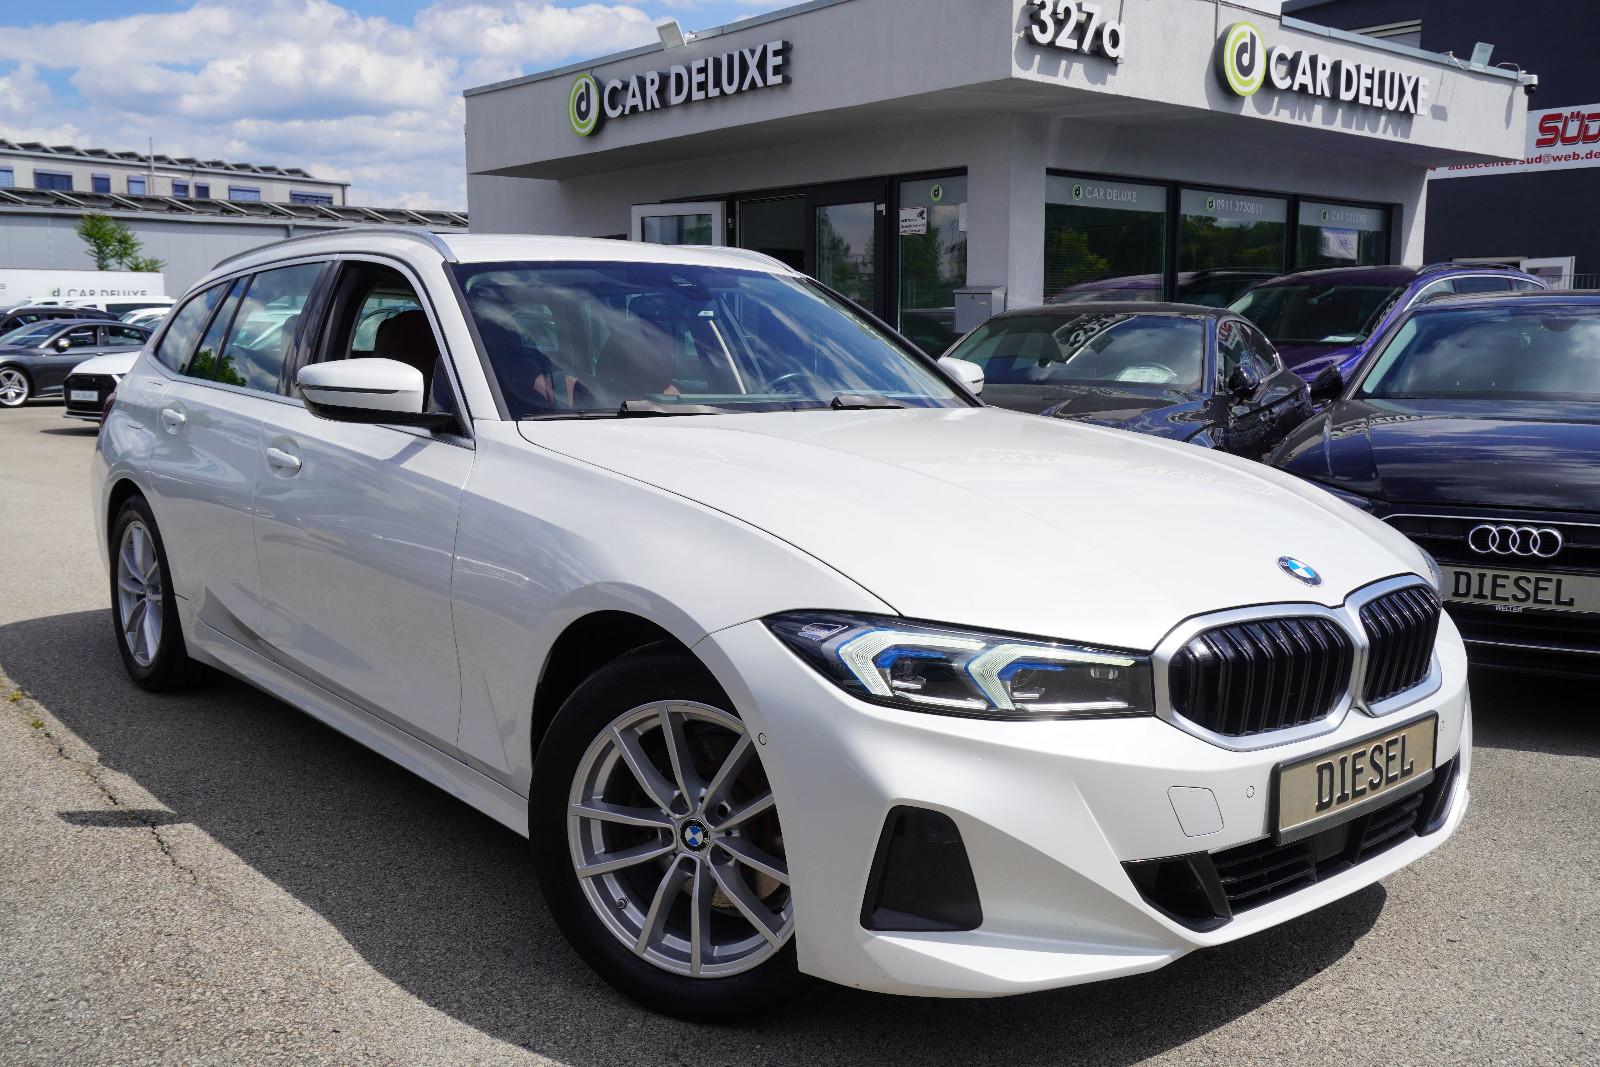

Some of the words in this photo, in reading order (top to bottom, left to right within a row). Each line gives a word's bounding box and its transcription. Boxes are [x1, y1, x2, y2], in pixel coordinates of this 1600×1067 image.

[1031, 0, 1126, 59] 327a
[603, 70, 661, 119] CAR
[670, 40, 784, 106] DELUXE
[1269, 44, 1331, 98] CAR
[1339, 59, 1430, 115] DELUXE
[1085, 186, 1105, 200] CAR
[1106, 188, 1137, 202] DELUXE
[1452, 570, 1575, 607] DIESEL
[1315, 734, 1414, 812] DIESEL
